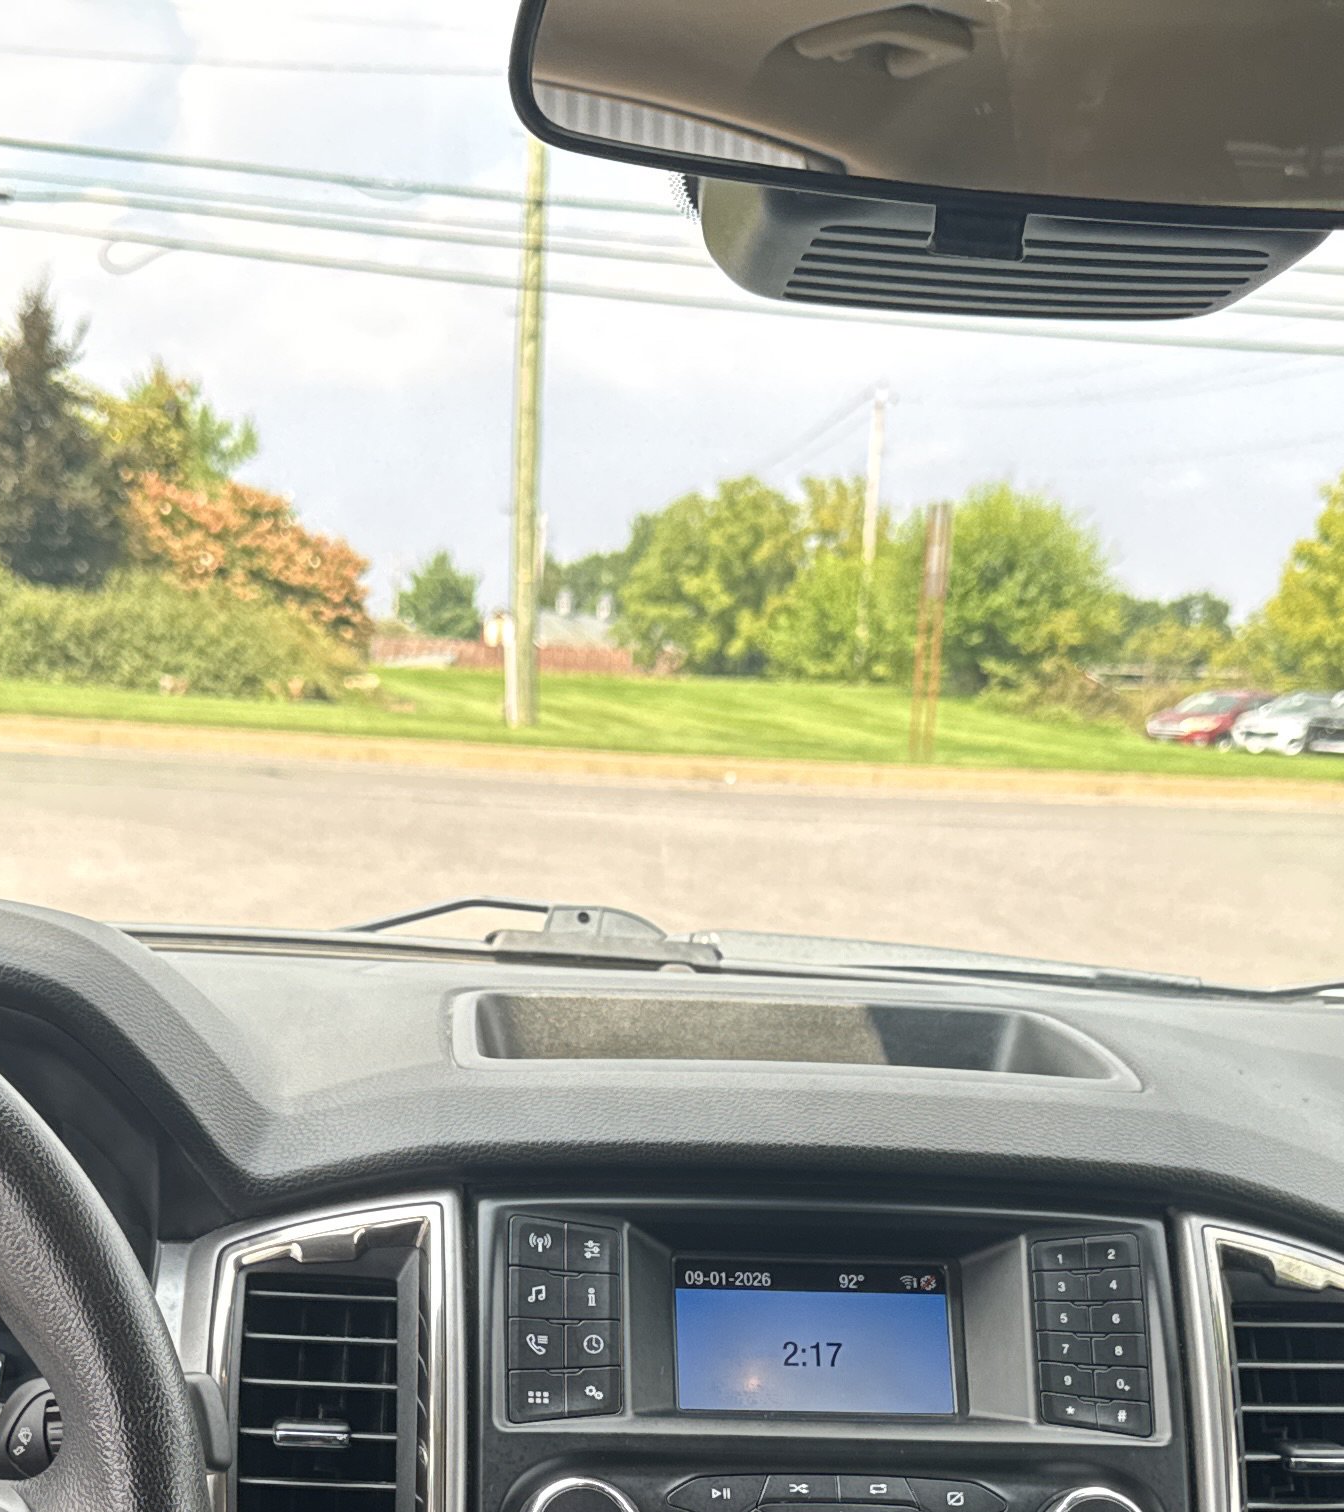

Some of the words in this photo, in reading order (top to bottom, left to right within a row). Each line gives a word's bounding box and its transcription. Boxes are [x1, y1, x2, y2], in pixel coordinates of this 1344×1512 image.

[1057, 1254, 1063, 1264] 1
[1107, 1249, 1116, 1260] 2
[685, 1270, 772, 1287] 09-01-2026
[838, 1274, 865, 1289] 92°
[1058, 1281, 1066, 1292] 3
[1109, 1280, 1117, 1290] 4
[1060, 1313, 1068, 1323] 5
[1112, 1313, 1120, 1324] 6
[783, 1342, 842, 1367] 2:17
[1062, 1343, 1070, 1354] 7
[1114, 1346, 1123, 1356] 8
[1064, 1375, 1072, 1386] 9
